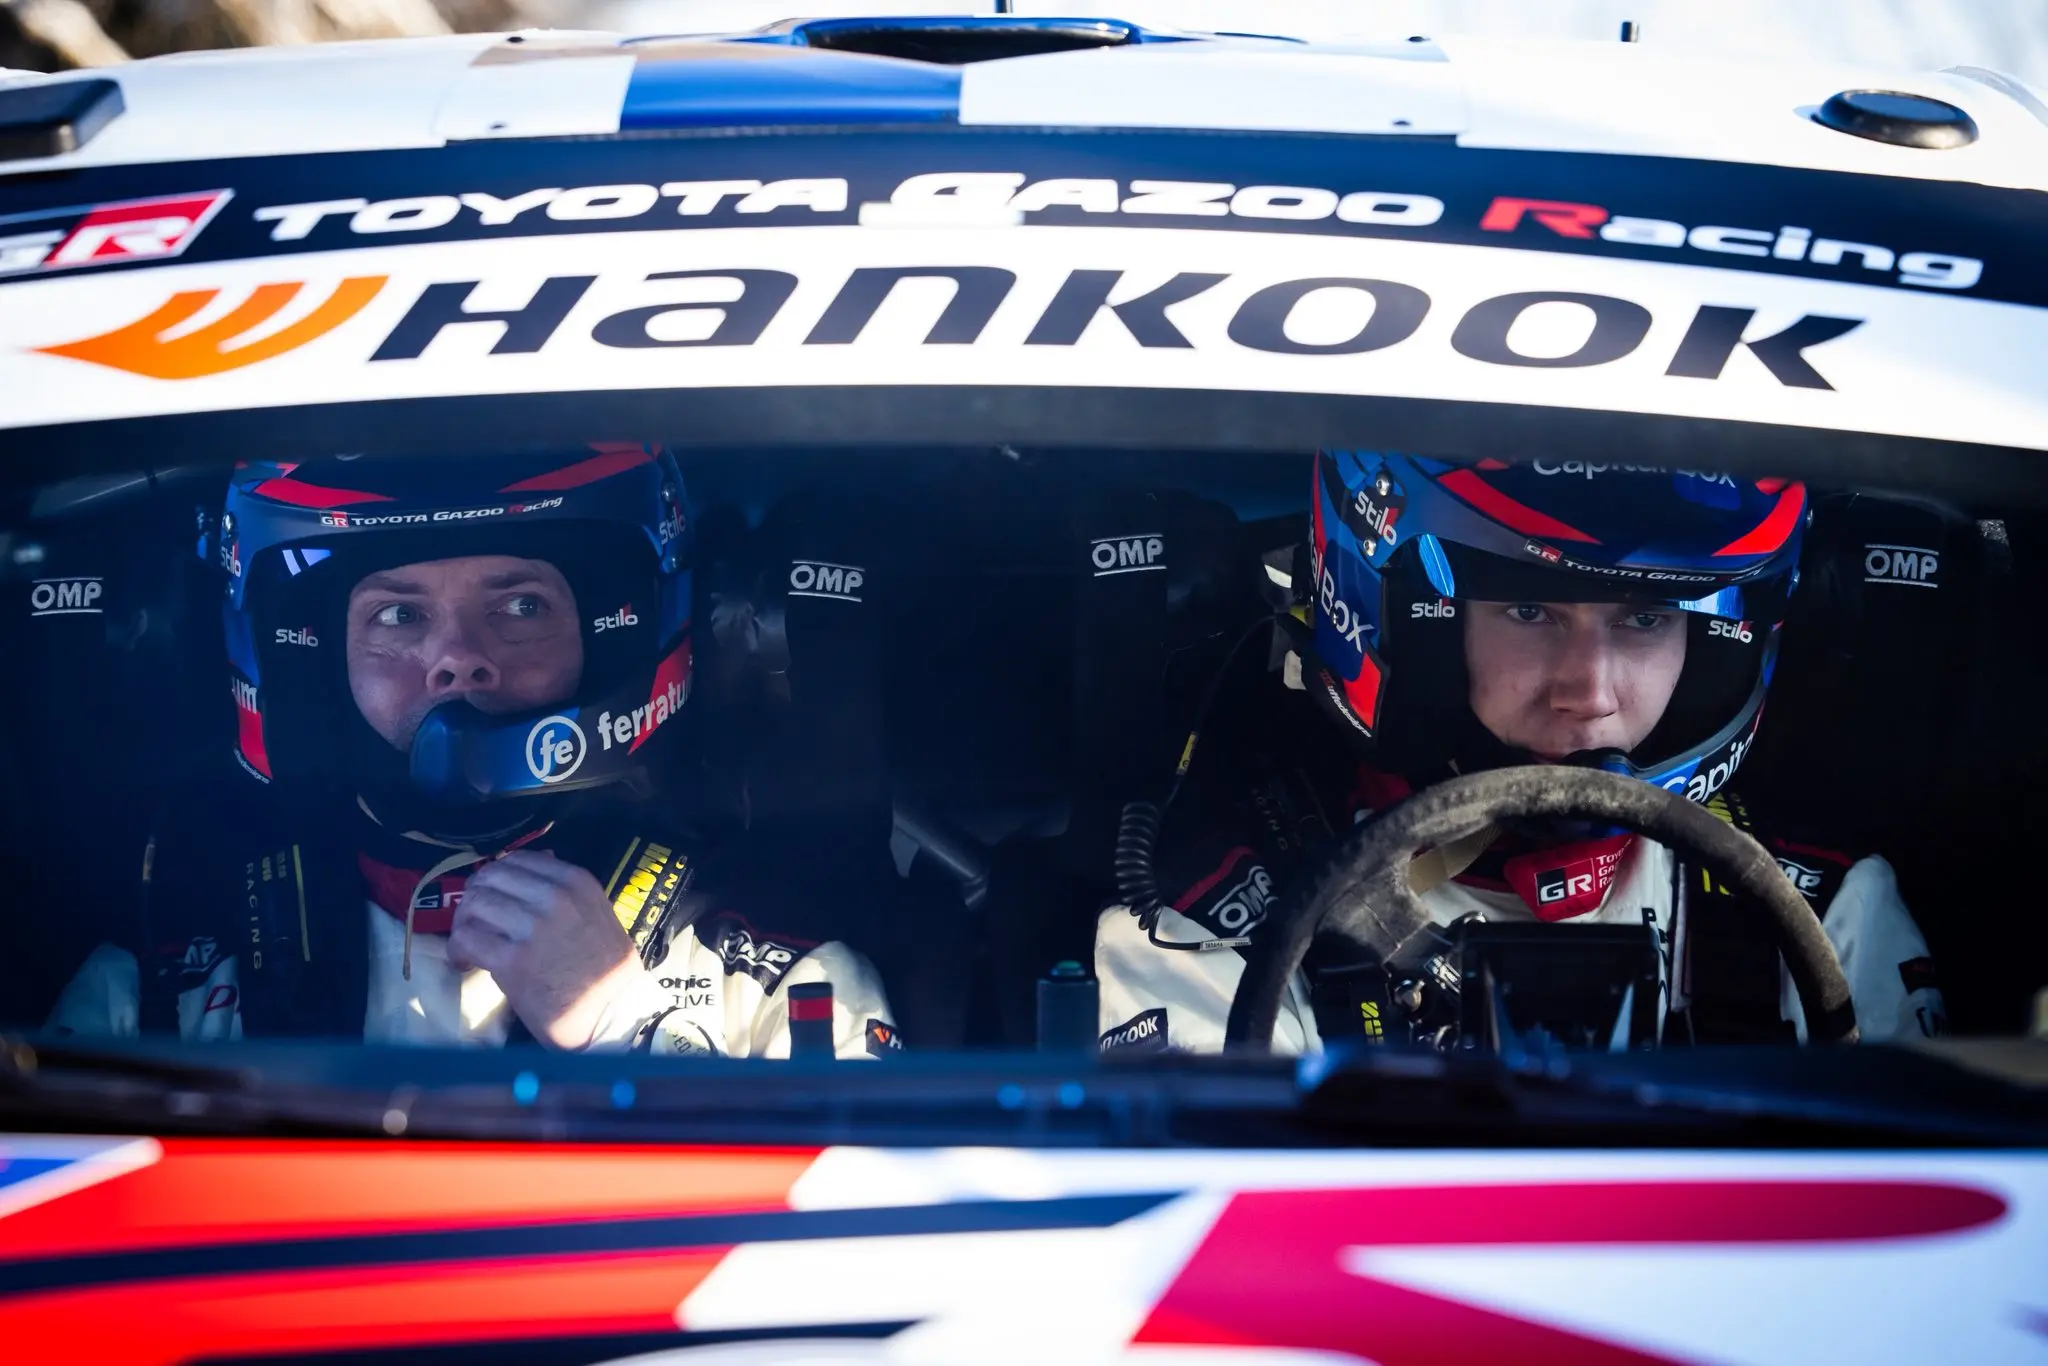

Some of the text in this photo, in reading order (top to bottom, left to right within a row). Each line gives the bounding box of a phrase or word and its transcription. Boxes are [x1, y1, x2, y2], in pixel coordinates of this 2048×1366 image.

[254, 178, 848, 241] TOYOTA
[1480, 196, 1983, 289] Racing
[321, 496, 563, 526] GR TOYOTA GAZOO Racing
[658, 506, 686, 545] Stilo
[1355, 492, 1397, 545] Stilo
[1092, 538, 1164, 568] OMP
[1865, 550, 1938, 580] OMP
[790, 564, 863, 595] OMP
[1563, 560, 1642, 580] TOYOTA
[1646, 572, 1716, 583] GAZOO
[31, 581, 102, 610] OMP
[1411, 601, 1455, 618] Stilo
[594, 606, 638, 633] Stilo
[1708, 619, 1752, 643] Stilo
[276, 627, 319, 648] Stilo
[635, 855, 688, 946] ACING
[1219, 869, 1273, 929] OMP
[1540, 873, 1593, 903] GR
